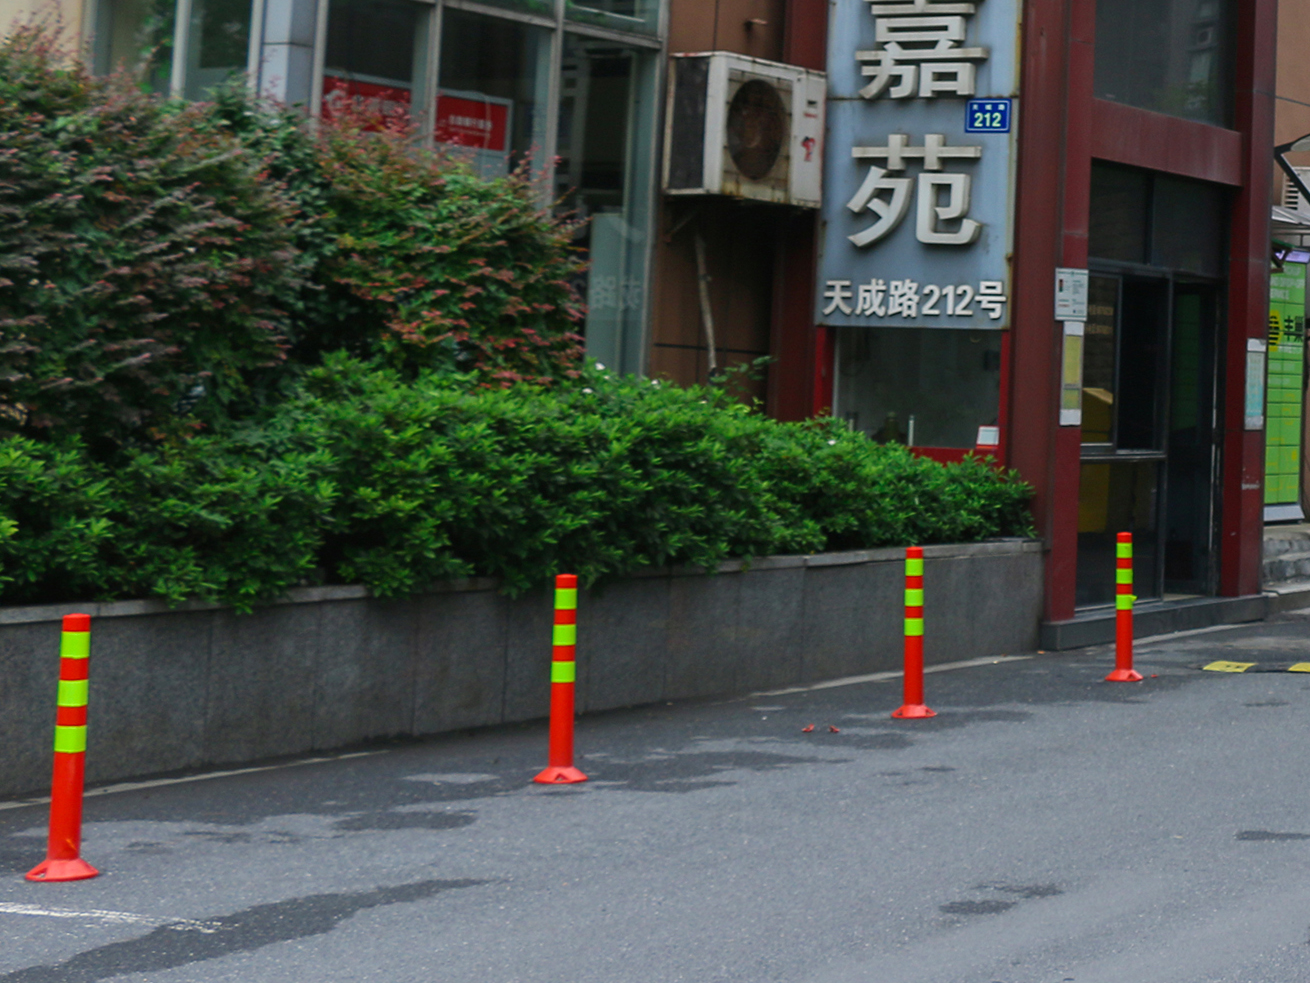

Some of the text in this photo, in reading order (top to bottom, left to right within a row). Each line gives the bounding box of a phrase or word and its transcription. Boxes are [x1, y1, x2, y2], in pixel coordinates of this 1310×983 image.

[974, 112, 1002, 127] 212
[822, 278, 1007, 319] 天成路212号
